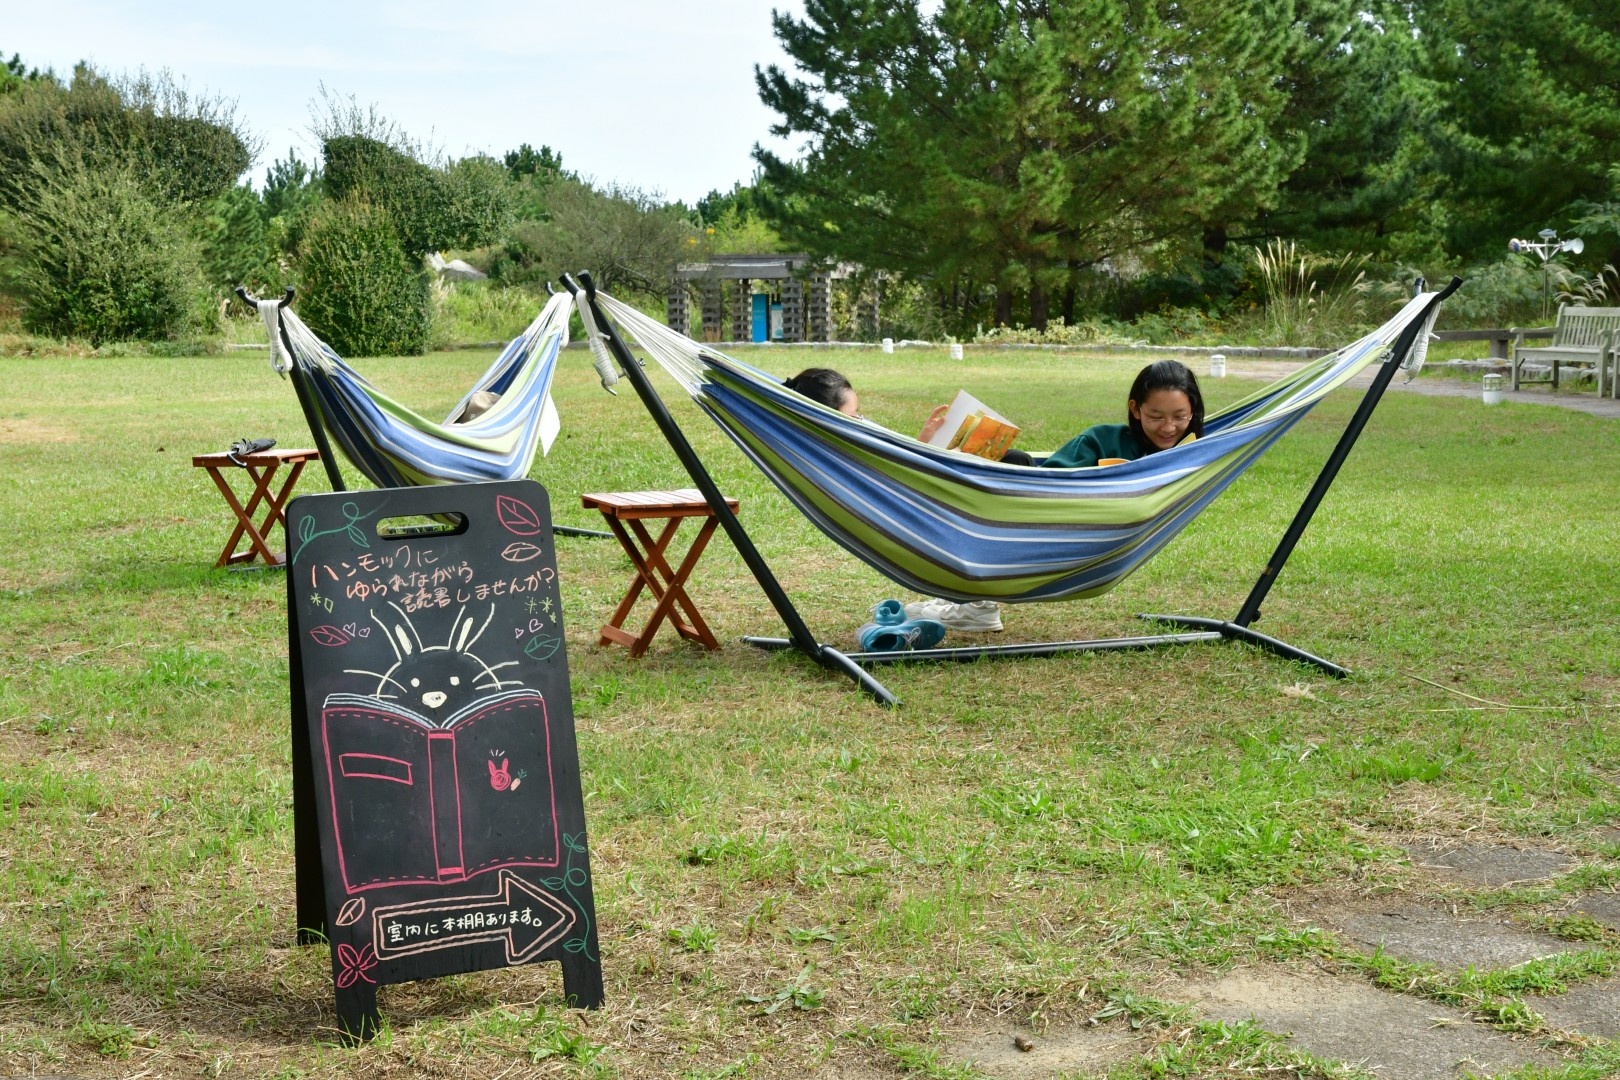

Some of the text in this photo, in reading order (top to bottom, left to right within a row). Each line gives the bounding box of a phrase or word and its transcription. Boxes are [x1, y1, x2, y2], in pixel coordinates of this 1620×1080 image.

[312, 545, 439, 588] ハンモックに
[346, 561, 473, 601] ゆられながら
[387, 907, 543, 943] 室内に本棚あります。
